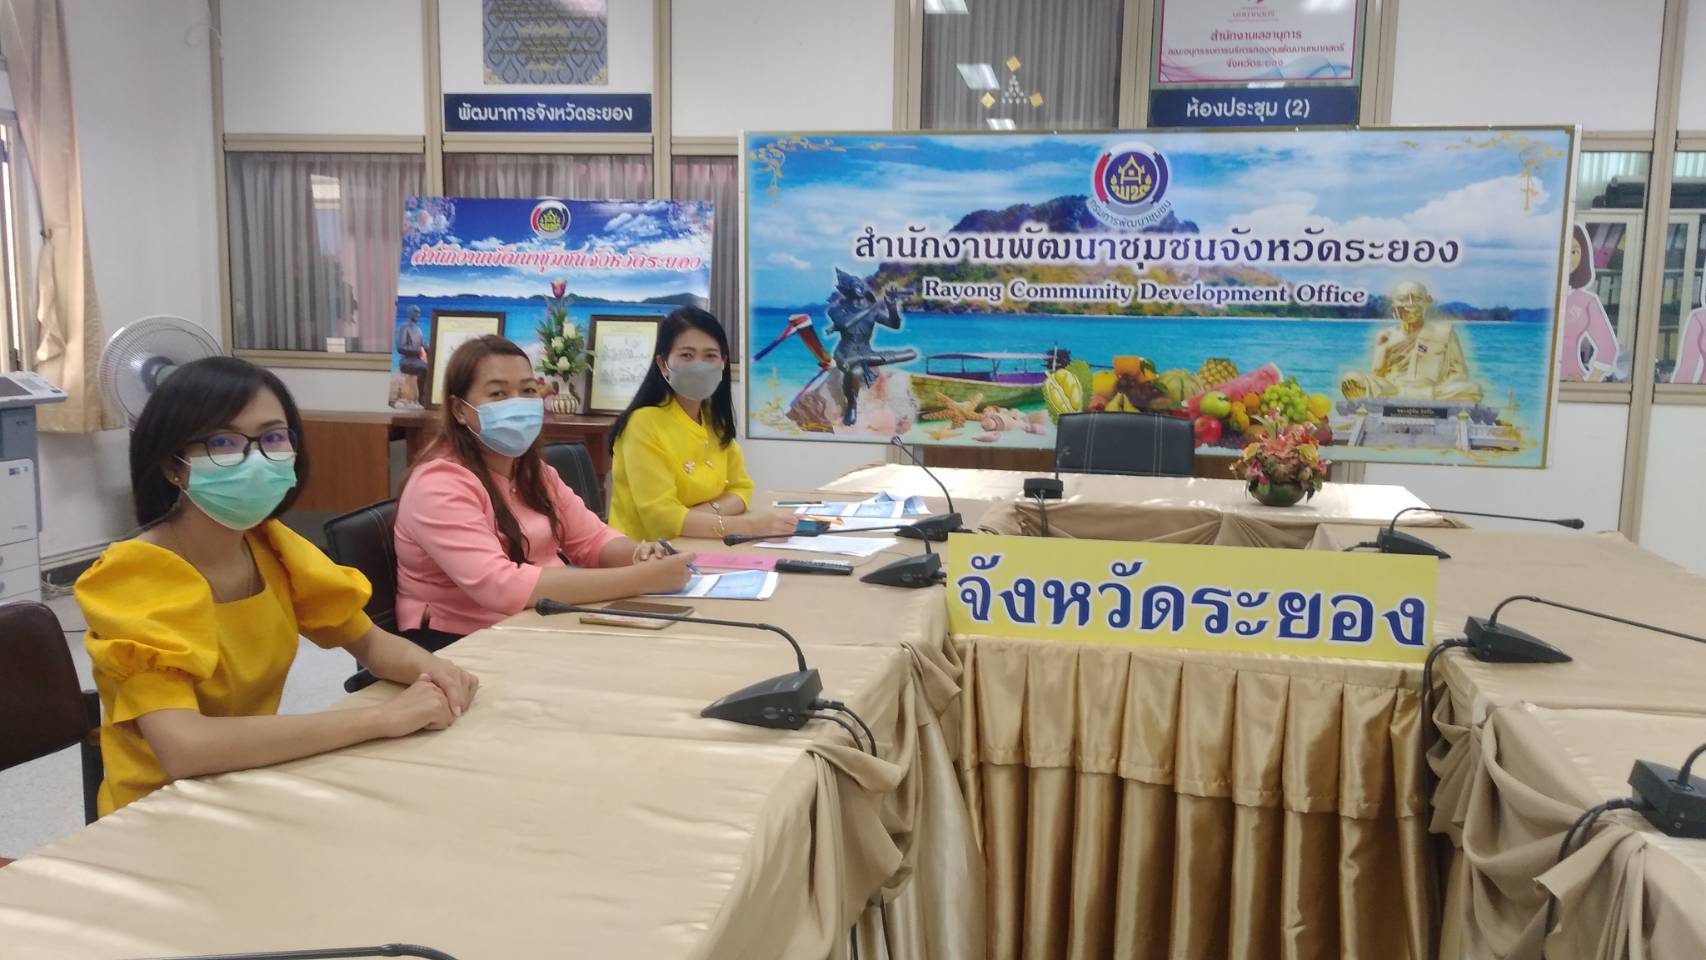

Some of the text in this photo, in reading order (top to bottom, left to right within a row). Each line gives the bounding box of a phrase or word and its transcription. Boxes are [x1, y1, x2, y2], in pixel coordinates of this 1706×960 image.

[458, 101, 633, 121] พัฒนาการจังหวัดระยอง
[1186, 97, 1310, 122] ห้องประชุม (2)
[411, 243, 702, 272] สำนักงานพัฒนาชุมชนจังหวัดระยอง
[855, 226, 1459, 270] สำนักงานพัฒนาชุมชนจังหวัดระยอง
[924, 279, 1366, 304] Rayong Community Development Office
[957, 554, 1426, 647] จังหวัดระยอง
